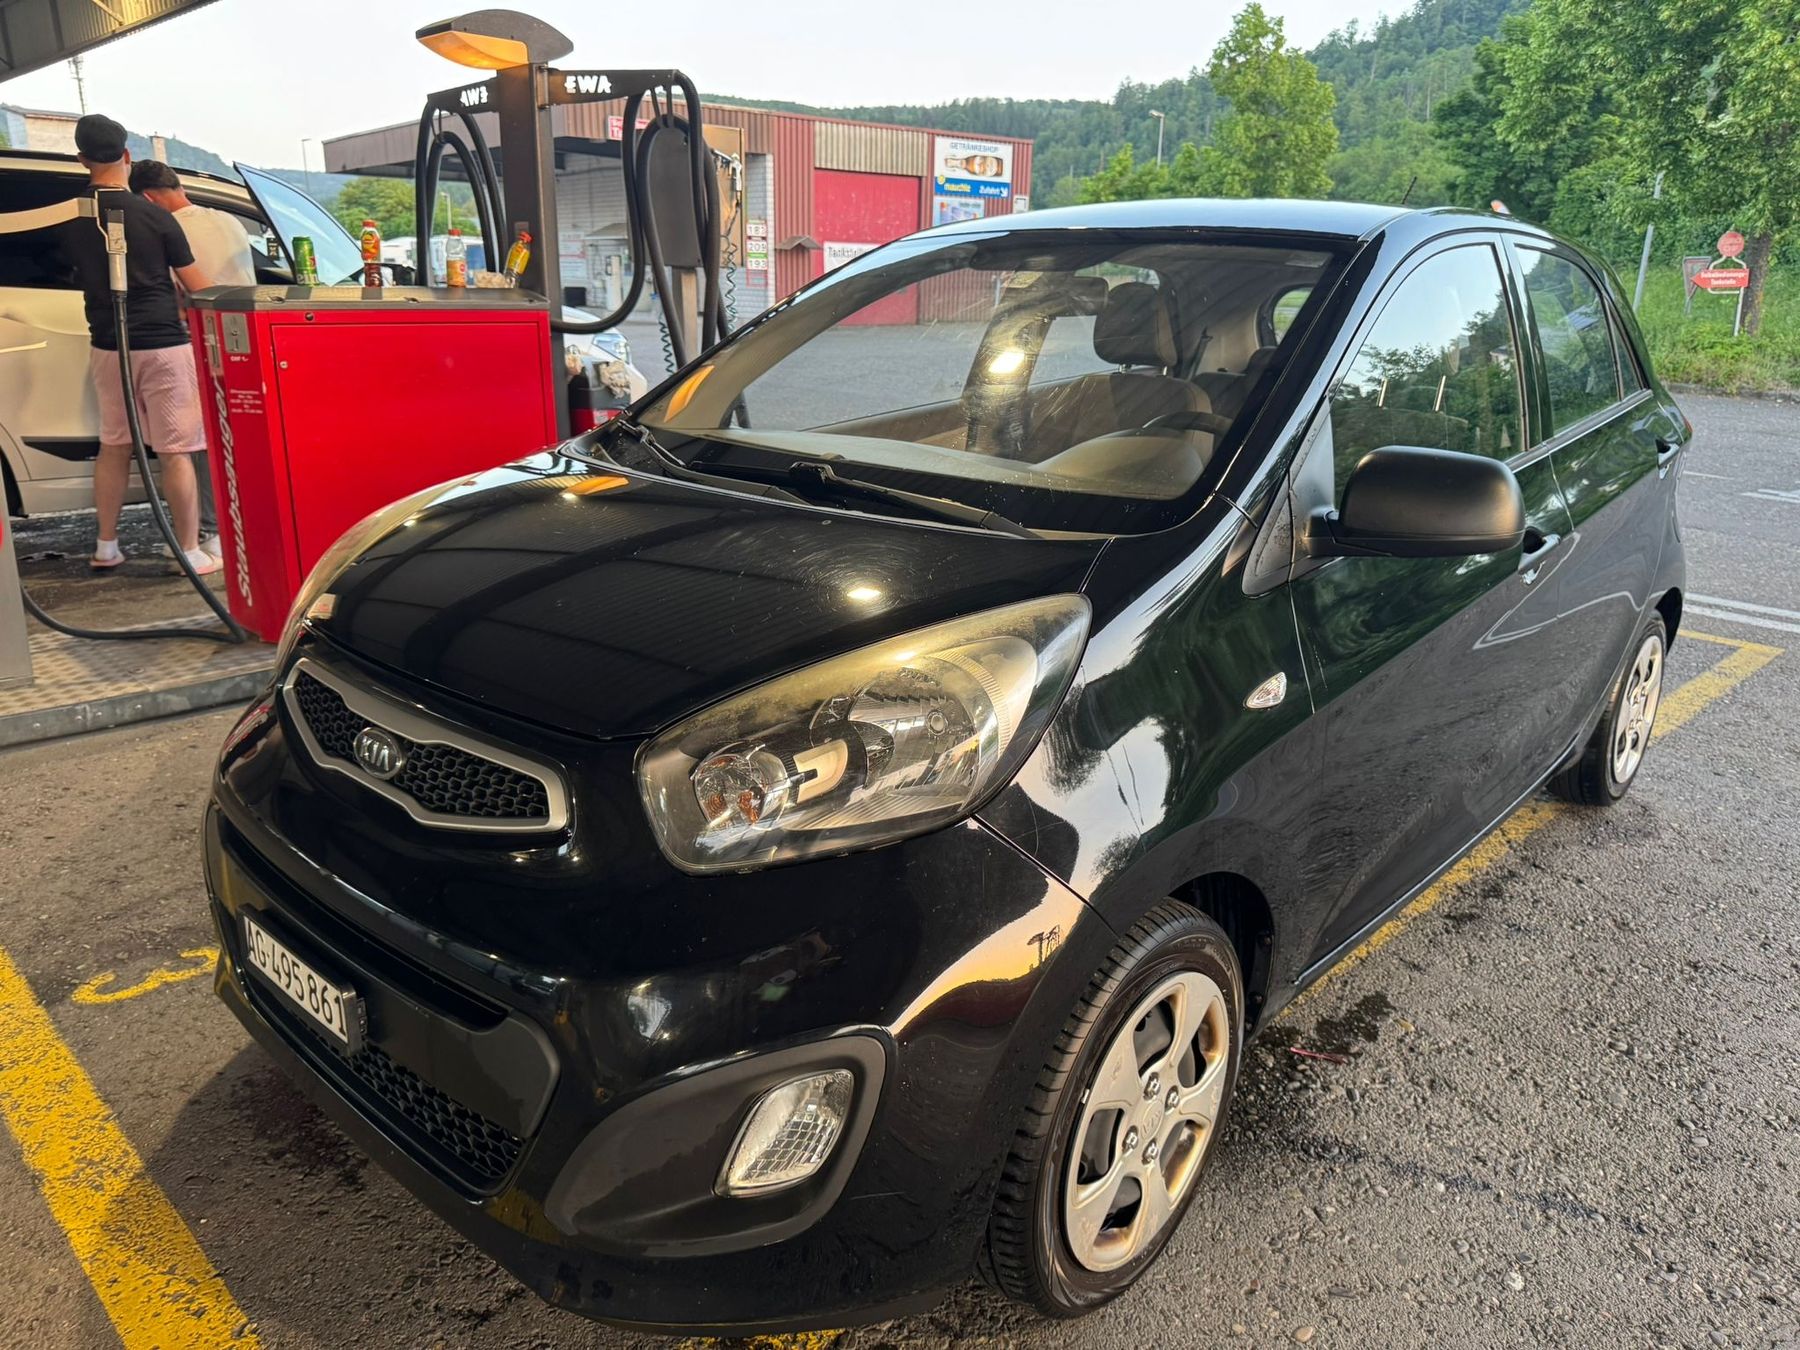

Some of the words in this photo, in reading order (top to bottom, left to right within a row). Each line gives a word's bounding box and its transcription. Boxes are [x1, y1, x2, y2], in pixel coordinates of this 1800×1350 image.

[564, 75, 612, 94] EWA
[212, 373, 252, 607] Staubsauger
[360, 735, 389, 771] KIA
